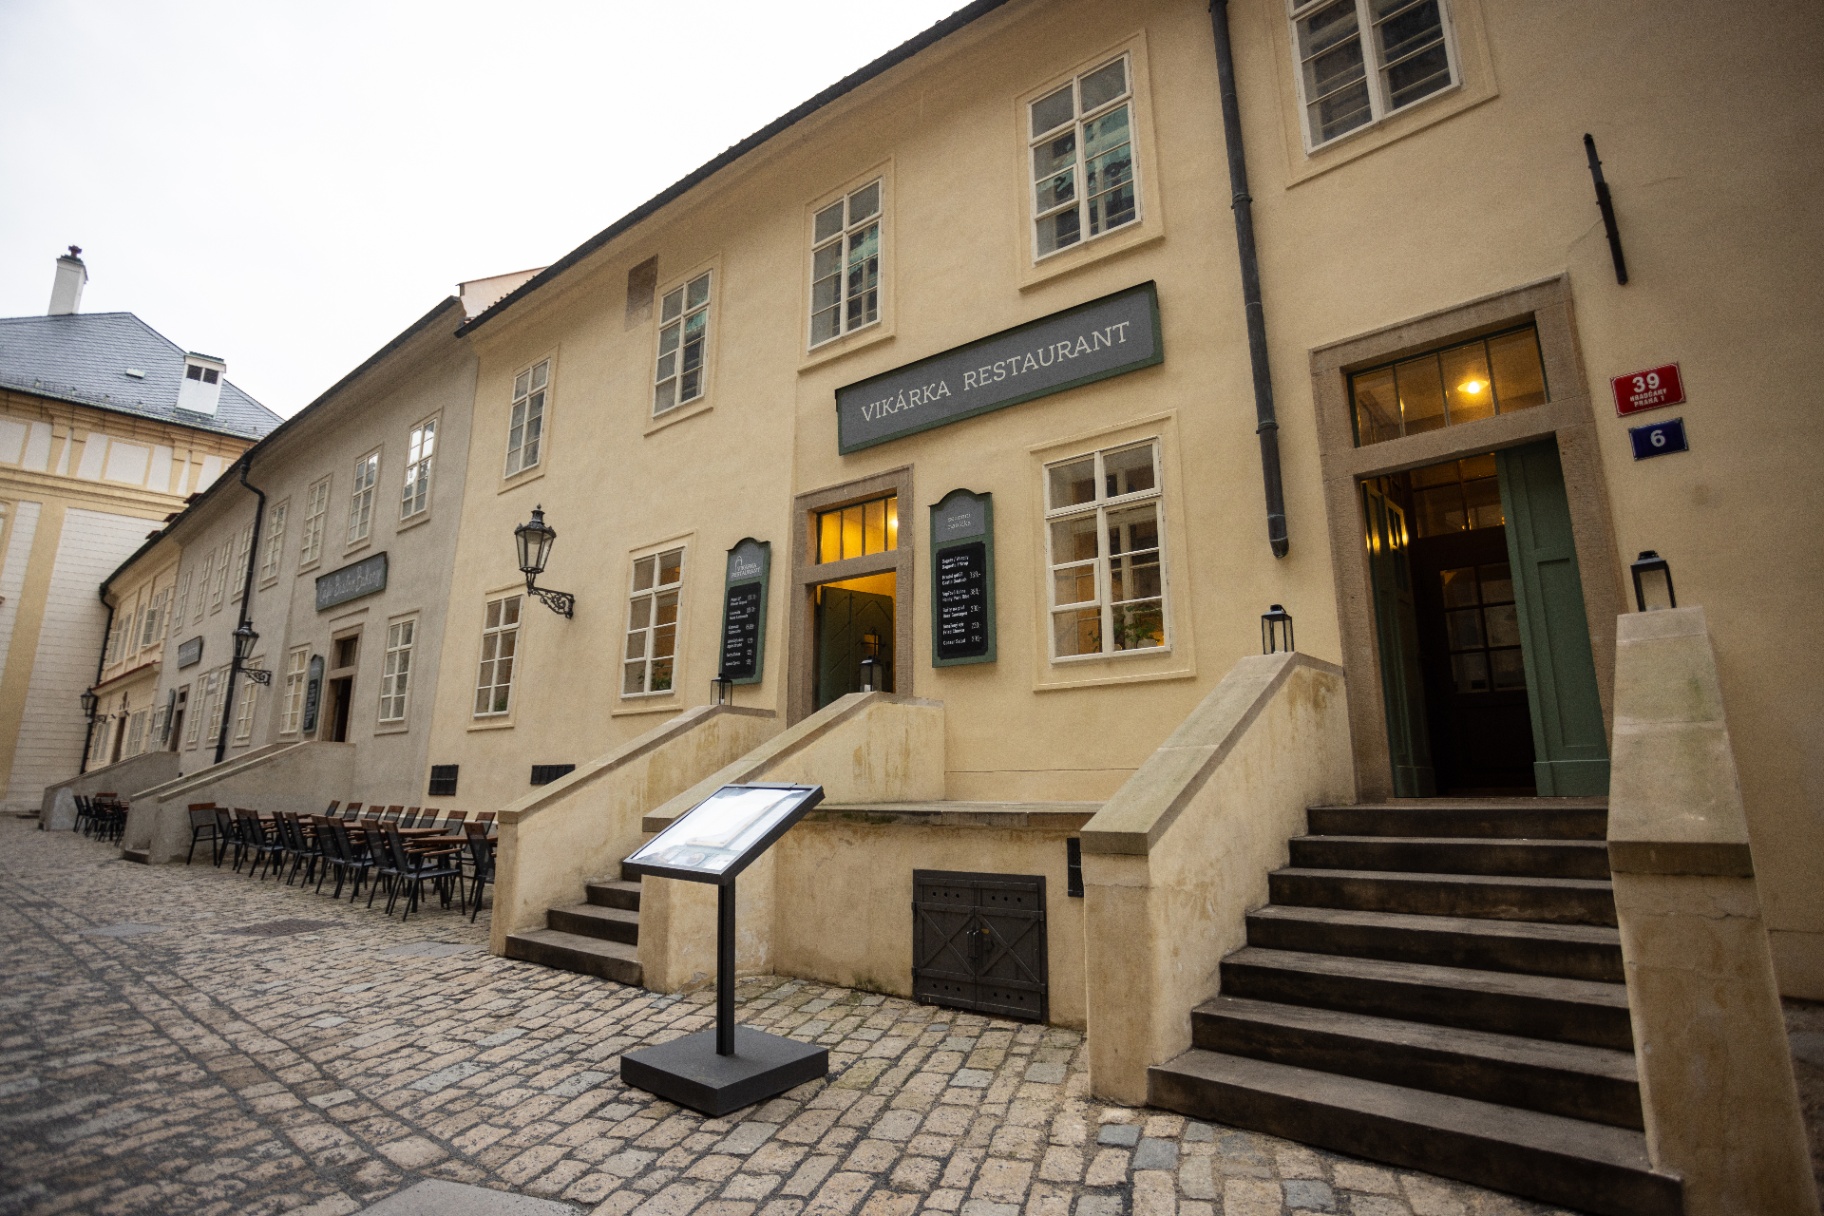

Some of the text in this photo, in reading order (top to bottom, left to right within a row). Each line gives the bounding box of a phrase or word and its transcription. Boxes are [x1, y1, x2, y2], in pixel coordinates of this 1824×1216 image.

[861, 321, 1131, 422] VIKÁRKA RESTAURANT
[1632, 373, 1659, 393] 39
[1630, 388, 1667, 402] HRADČANY
[1634, 397, 1659, 408] PRAHA
[1650, 429, 1666, 447] 6
